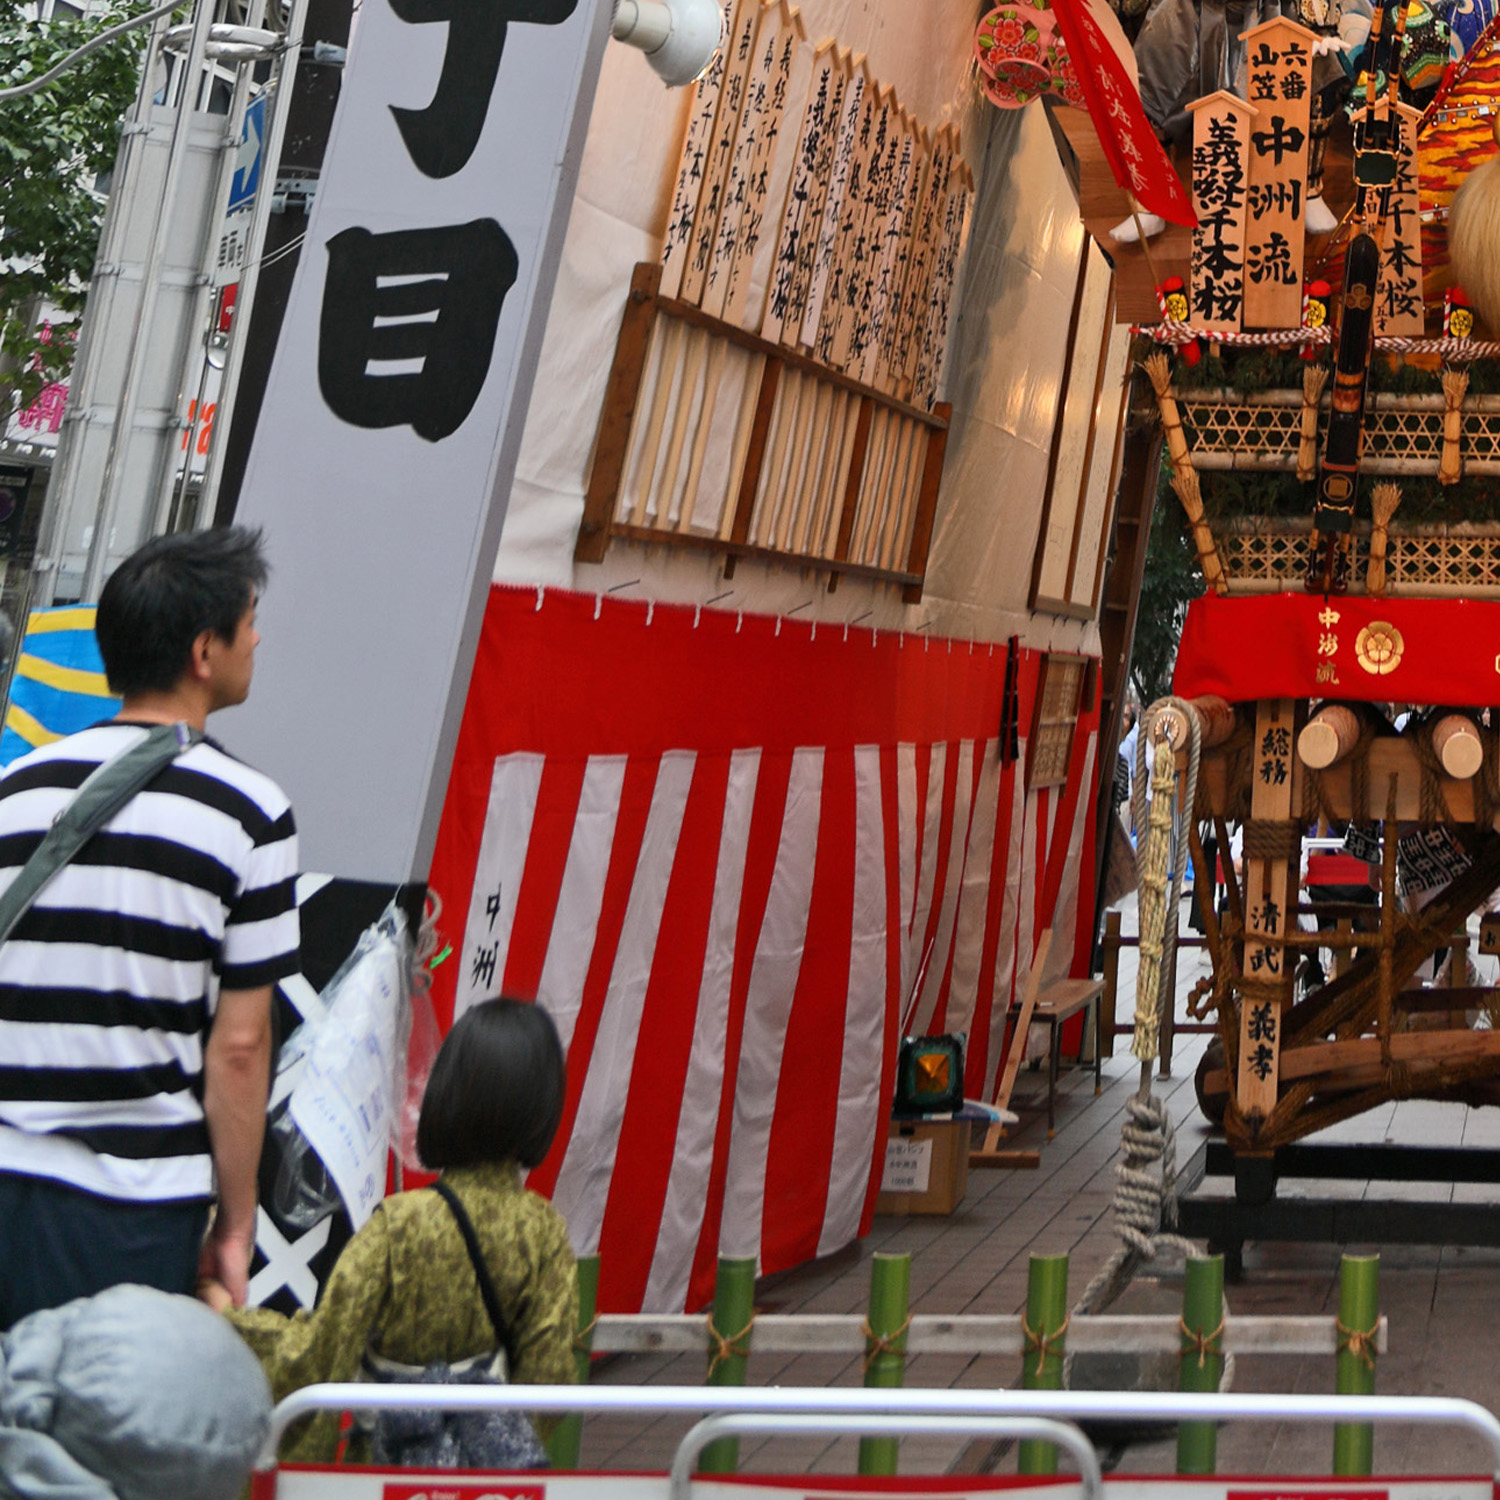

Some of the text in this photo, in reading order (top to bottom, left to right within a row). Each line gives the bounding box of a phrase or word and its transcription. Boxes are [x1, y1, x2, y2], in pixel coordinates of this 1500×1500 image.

[1250, 43, 1280, 102] 山笠
[1281, 42, 1308, 101] 六番
[1192, 112, 1247, 321] 義経千本桜
[1247, 115, 1306, 286] 中洲流
[1316, 607, 1341, 685] 中洲流
[1261, 727, 1291, 785] 総務
